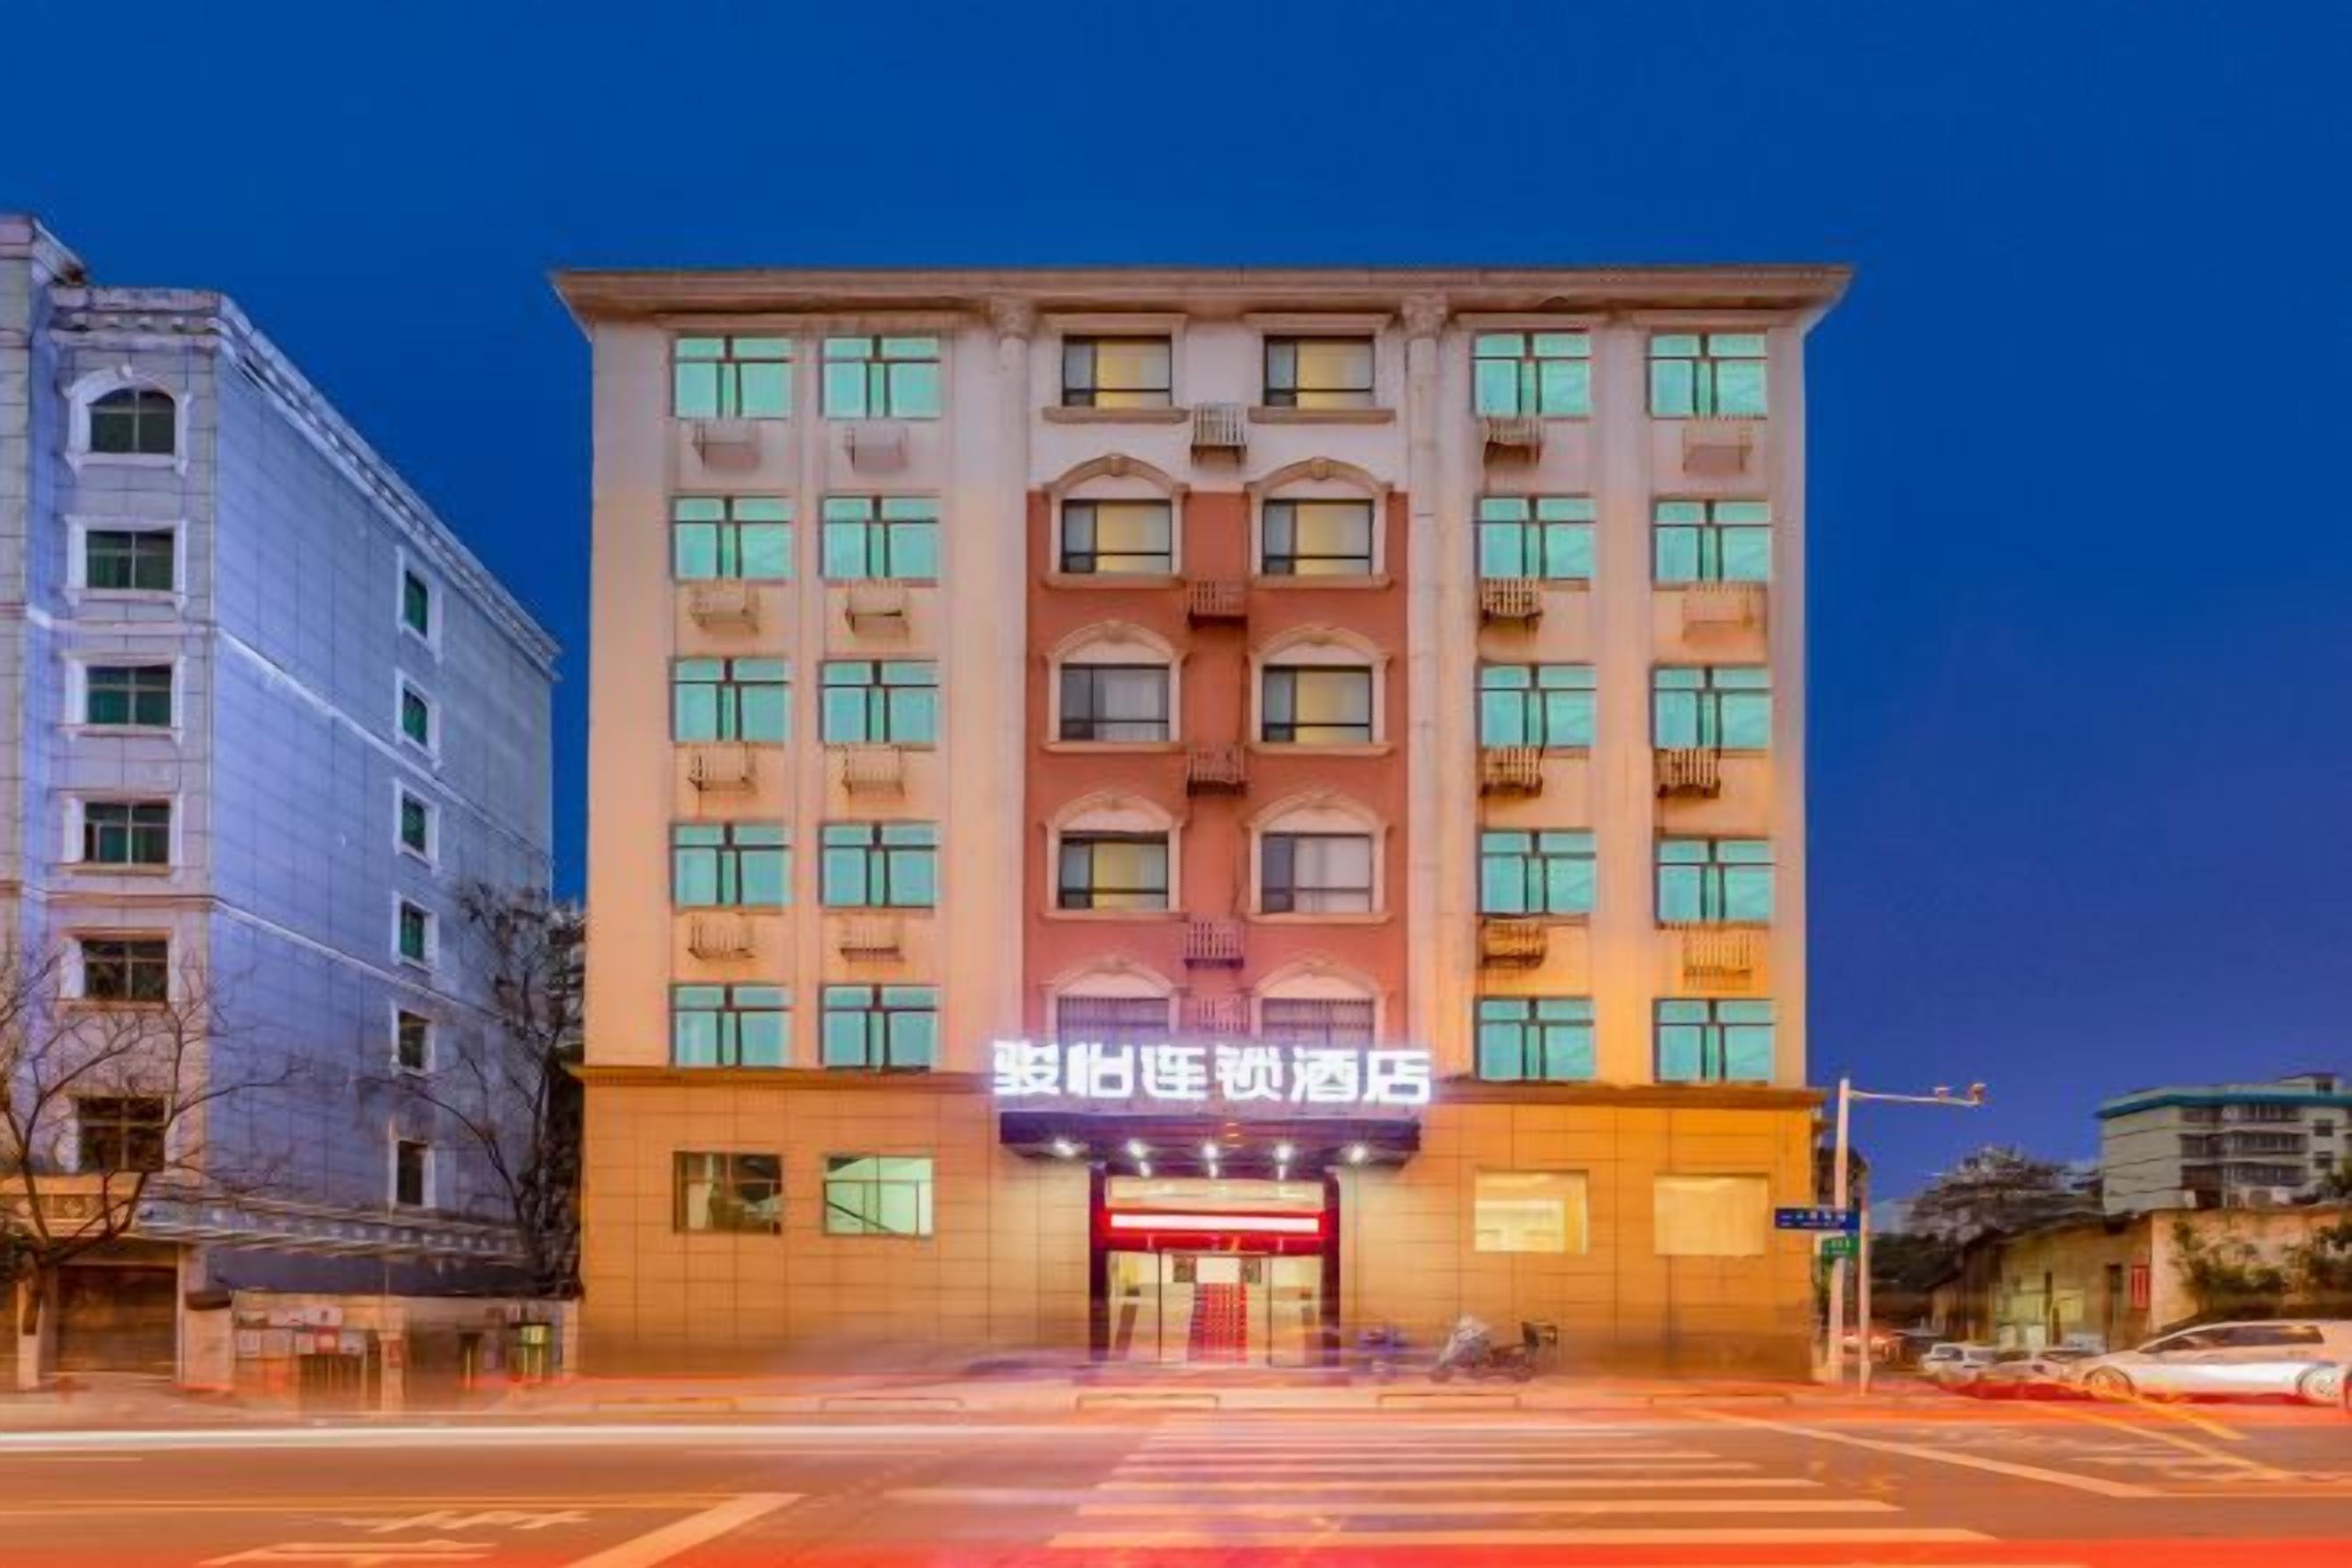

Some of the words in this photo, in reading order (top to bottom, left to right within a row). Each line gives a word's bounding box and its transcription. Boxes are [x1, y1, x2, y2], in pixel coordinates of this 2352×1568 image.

[992, 1040, 1431, 1104] 骏怡连锁酒店
